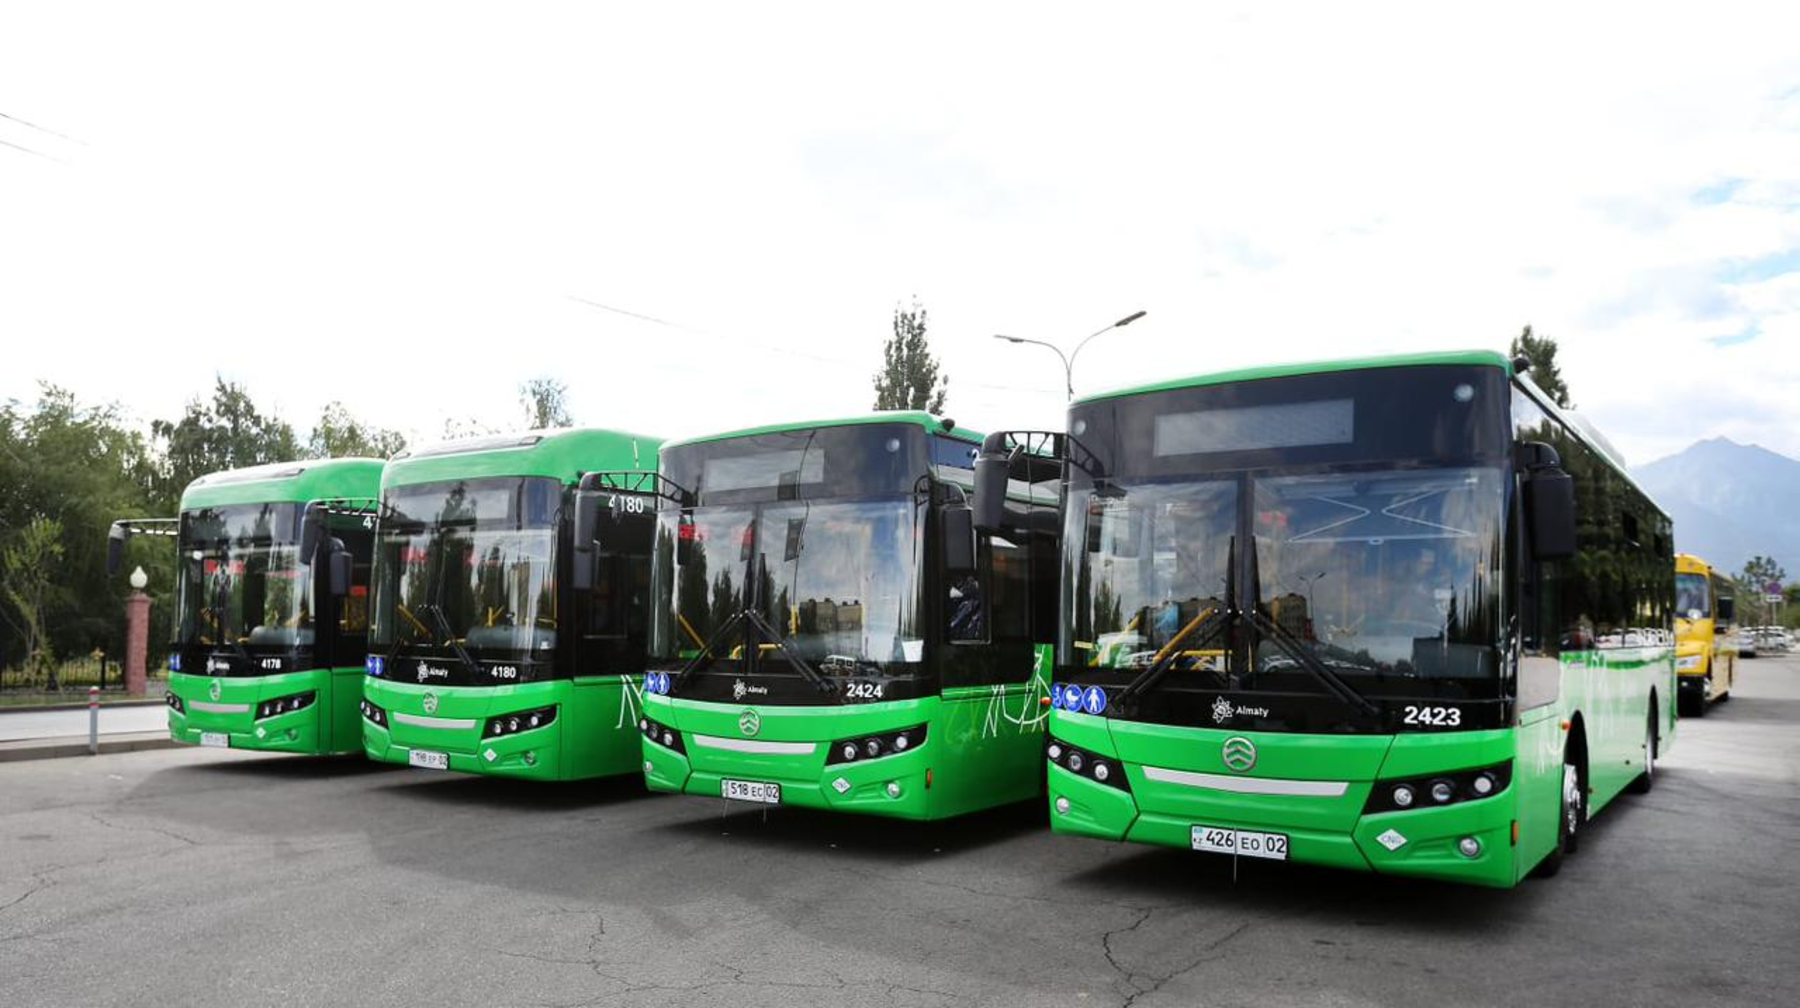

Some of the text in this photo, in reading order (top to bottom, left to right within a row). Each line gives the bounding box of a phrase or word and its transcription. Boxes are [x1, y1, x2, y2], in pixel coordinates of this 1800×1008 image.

[608, 494, 644, 513] 4180
[261, 658, 282, 669] 4178
[491, 665, 516, 678] 4180
[846, 683, 883, 698] 2424
[1236, 705, 1269, 718] Almaty
[1403, 705, 1461, 726] 2423
[730, 782, 749, 796] 518
[765, 786, 779, 799] 02
[1206, 830, 1286, 854] 426 EO 02
